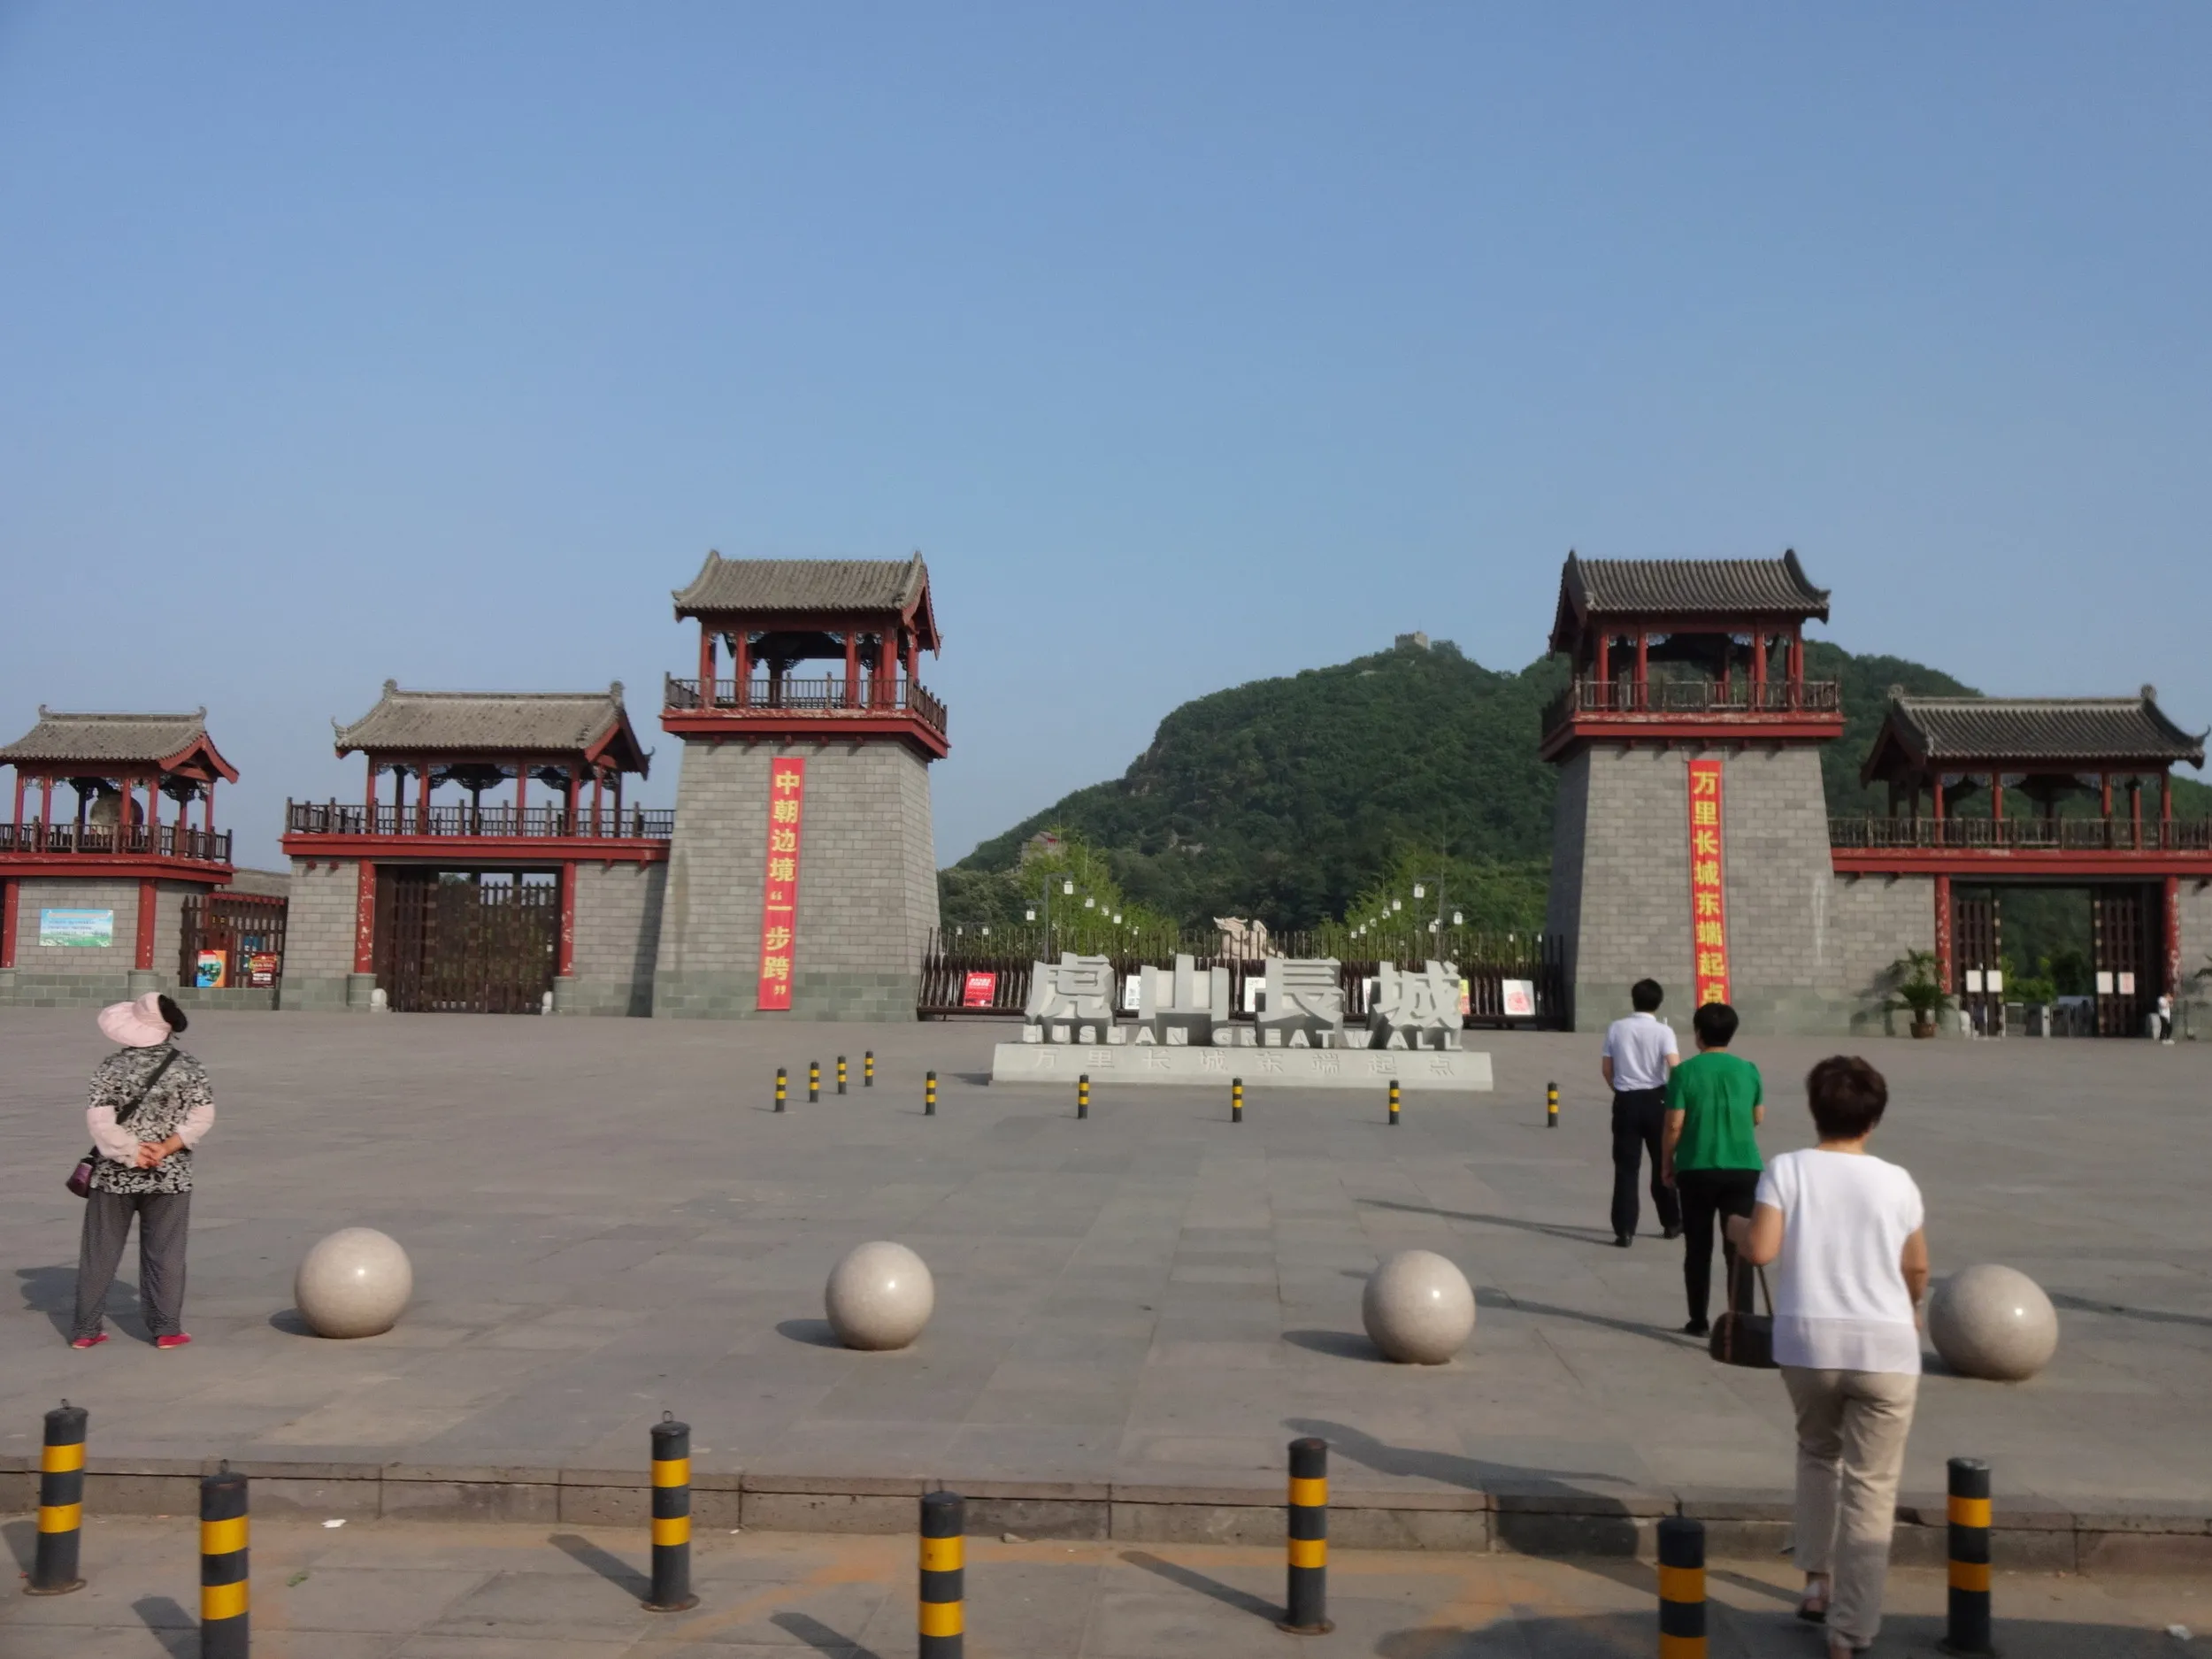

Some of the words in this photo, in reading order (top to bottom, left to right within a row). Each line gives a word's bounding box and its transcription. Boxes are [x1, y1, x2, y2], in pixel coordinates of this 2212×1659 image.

[762, 770, 800, 996] 中朝边境“一步跨”
[1692, 771, 1726, 1005] 万里长城东端起点
[1023, 1024, 1189, 1046] HUSHAN
[1212, 1026, 1336, 1050] GREAT
[1343, 1029, 1463, 1051] WALL
